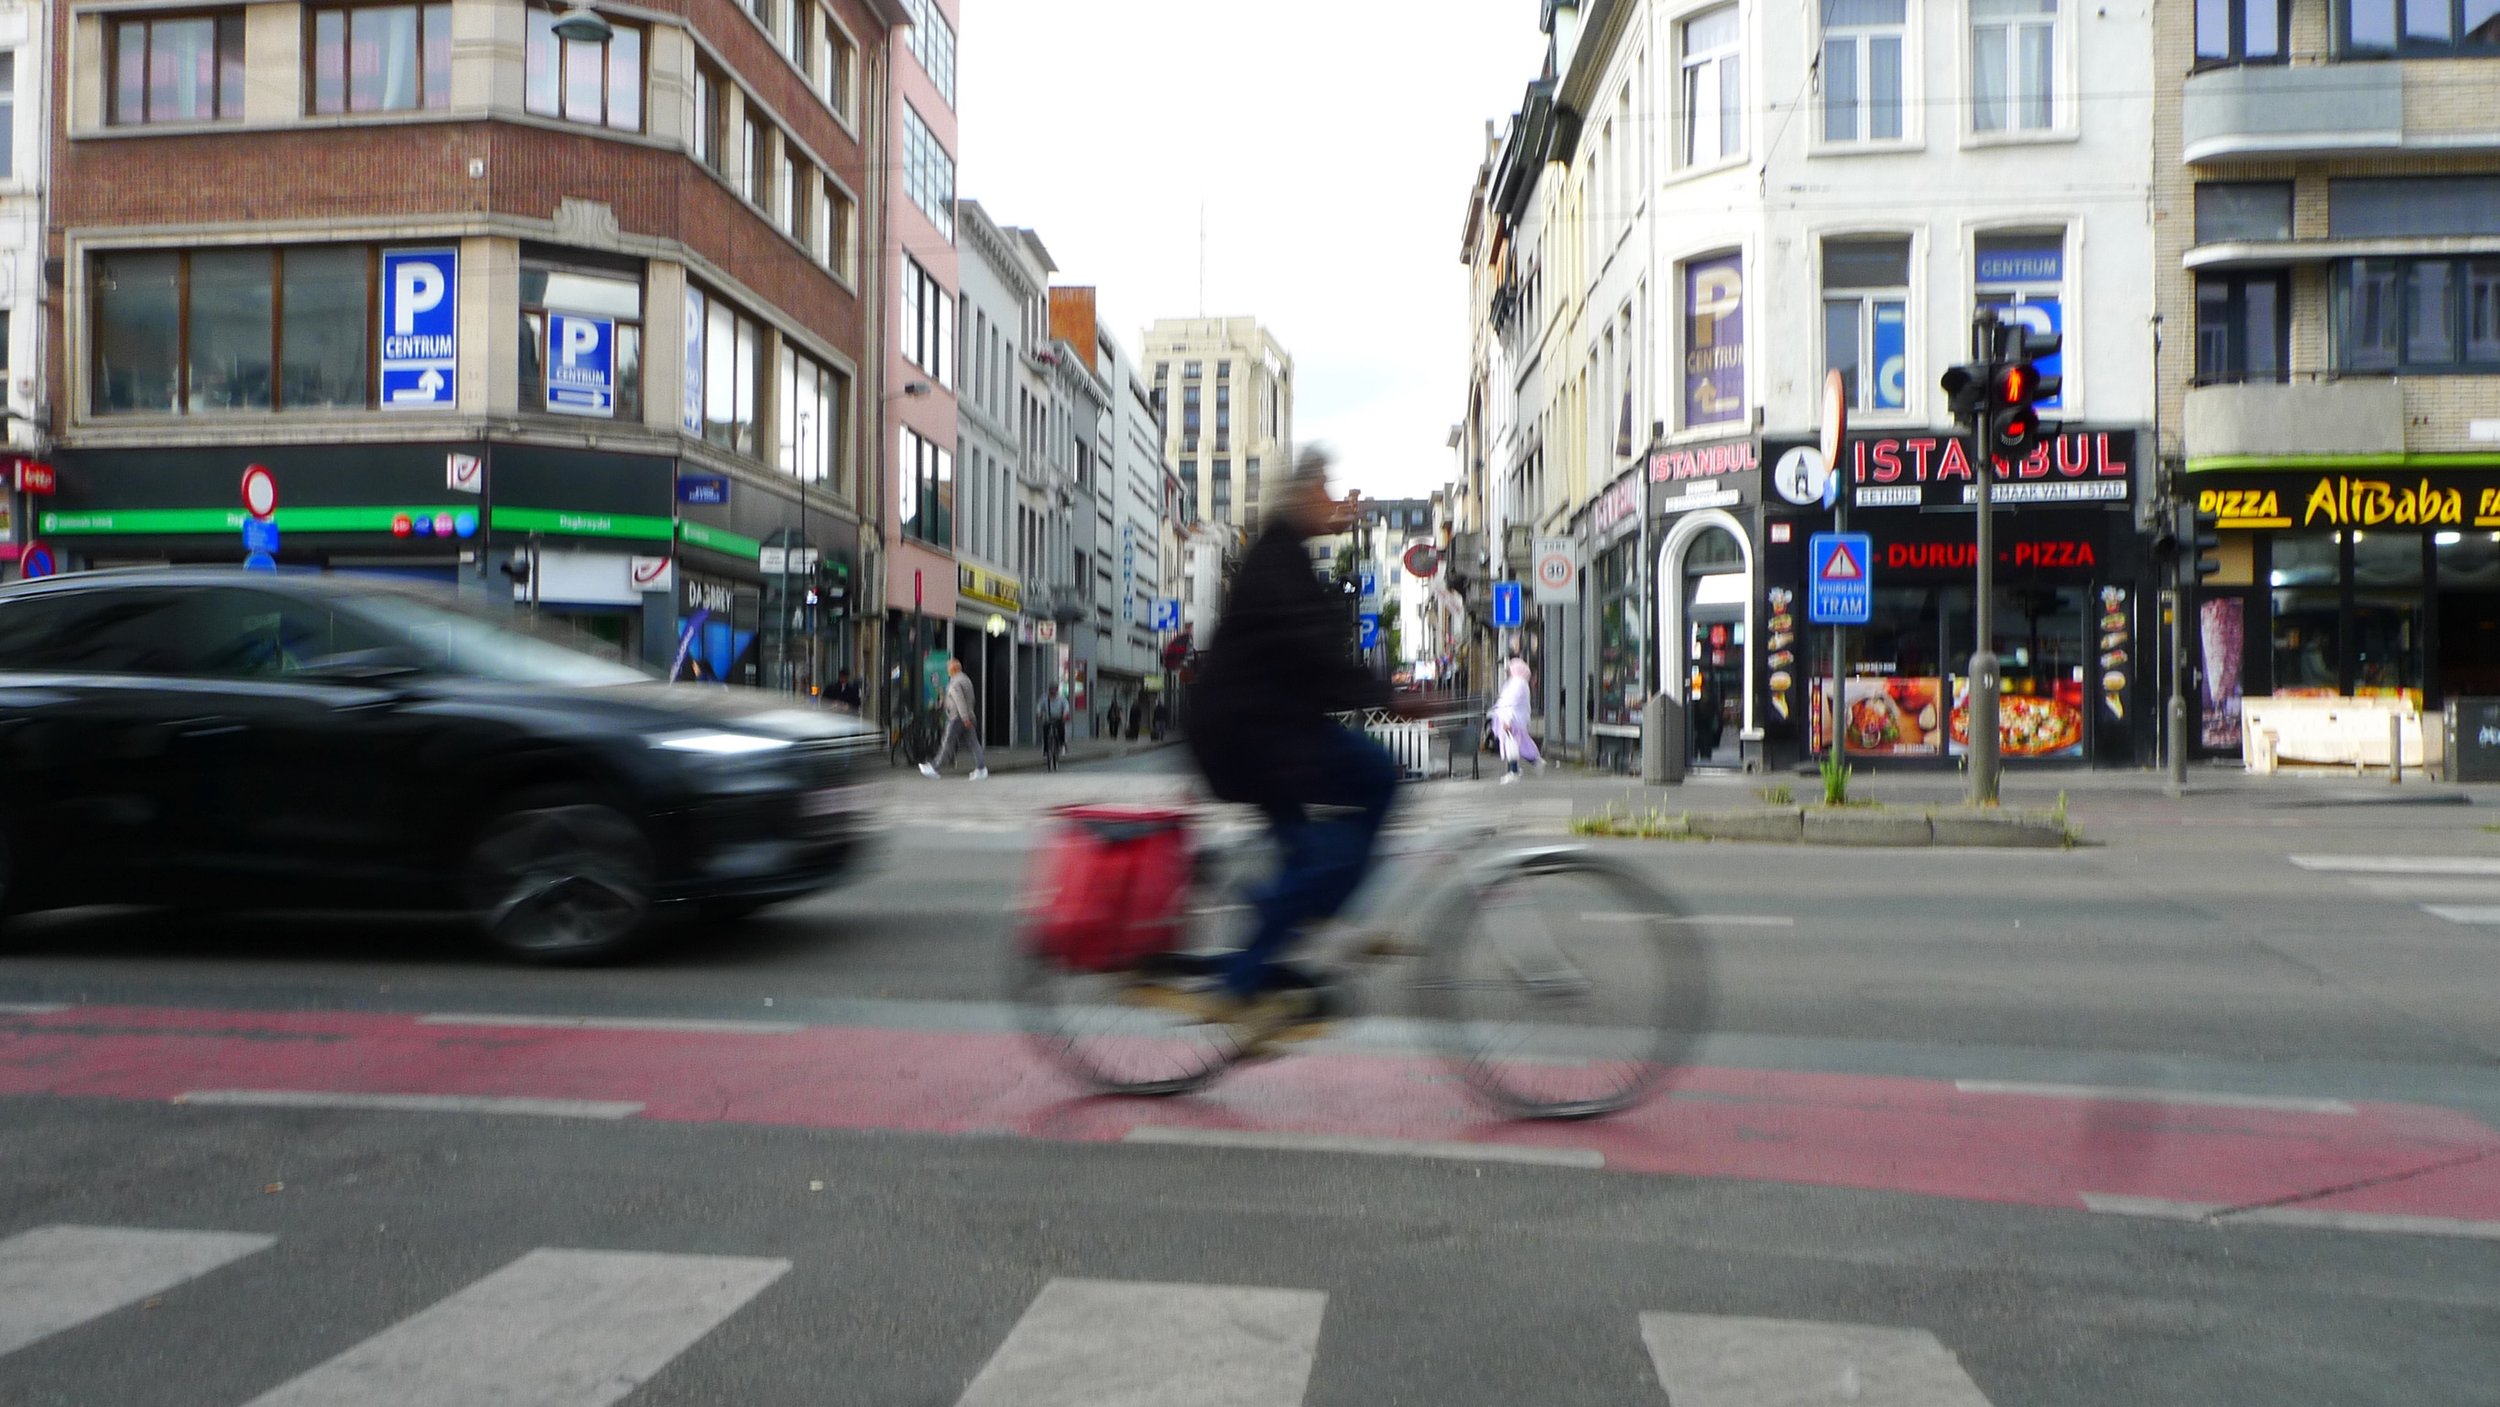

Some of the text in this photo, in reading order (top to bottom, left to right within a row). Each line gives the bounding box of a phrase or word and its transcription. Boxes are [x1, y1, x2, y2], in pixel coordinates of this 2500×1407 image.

[1981, 258, 2056, 277] CENTRUM
[395, 261, 445, 336] P
[1695, 266, 1742, 348] P
[385, 334, 453, 358] CENTRUM
[562, 318, 600, 368] P
[556, 367, 605, 387] CENTRUM
[1649, 442, 1757, 483] ISTANBUL
[1861, 487, 1917, 505] EETHUIS
[2041, 482, 2068, 499] VAN
[2087, 481, 2122, 498] STAD
[2199, 490, 2278, 518] PIZZA
[2015, 542, 2095, 567] PIZZA
[1818, 582, 1865, 594] VOORRANG
[1822, 597, 1862, 616] TRAM
